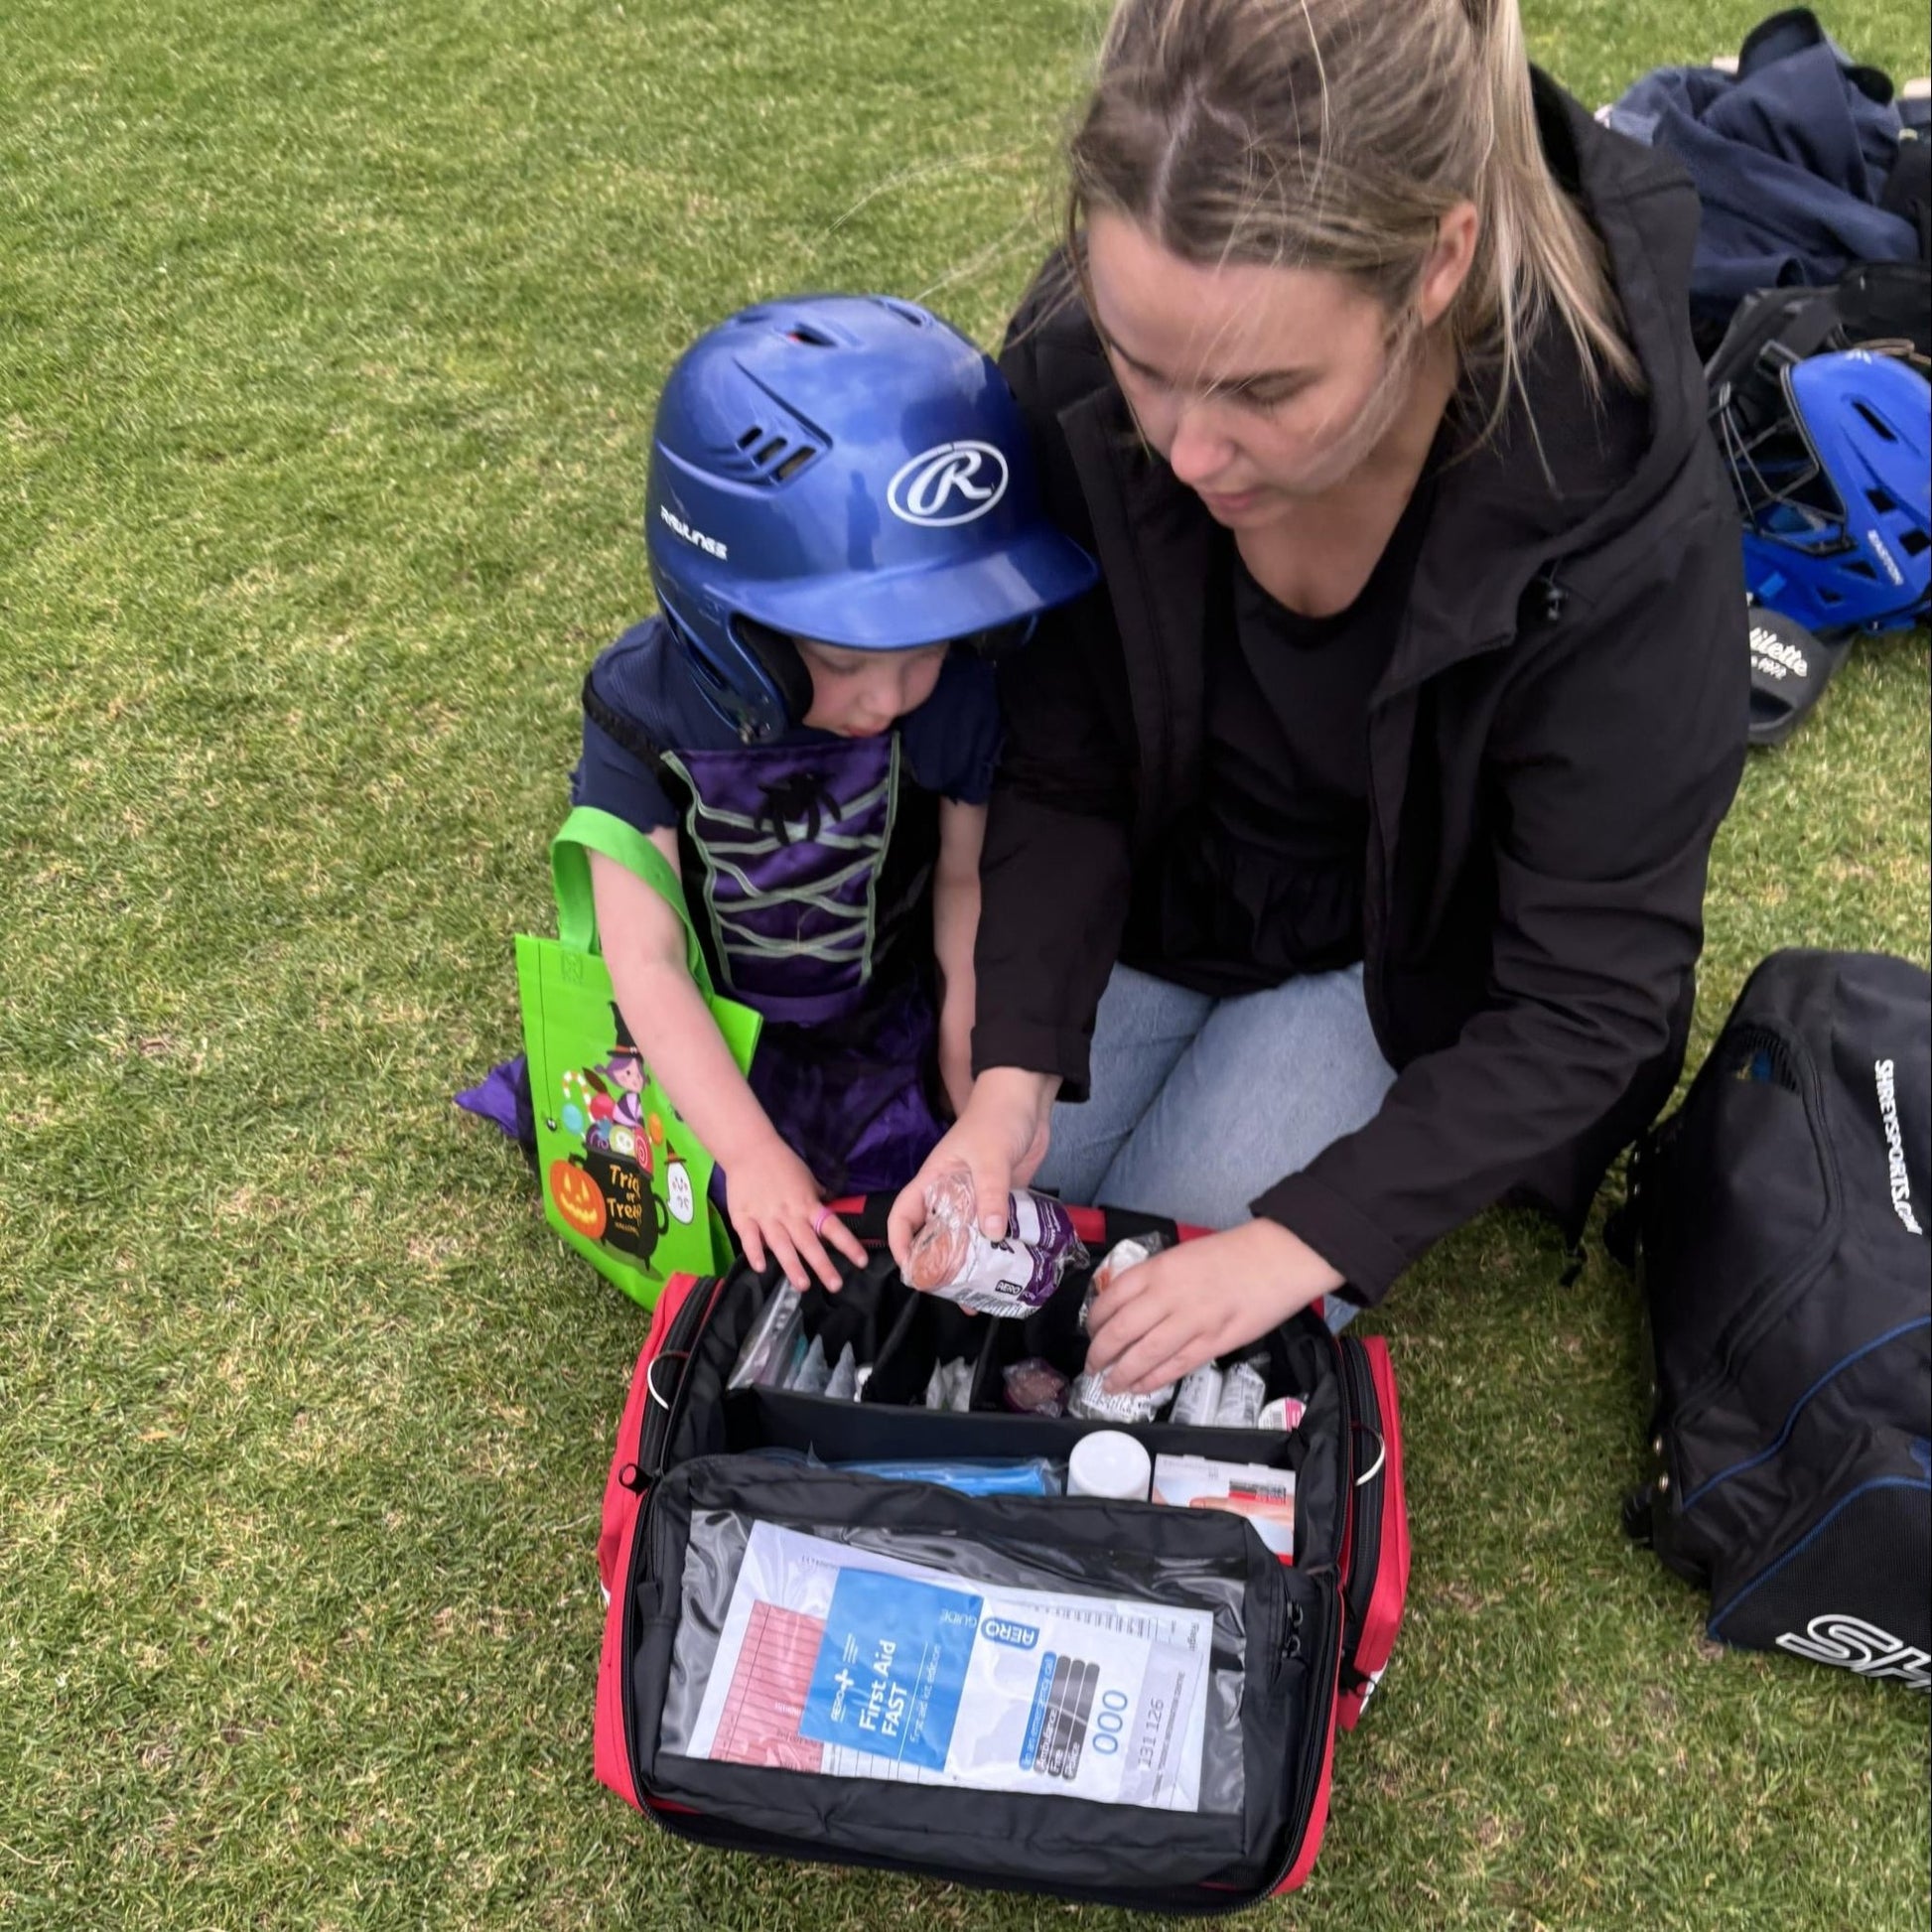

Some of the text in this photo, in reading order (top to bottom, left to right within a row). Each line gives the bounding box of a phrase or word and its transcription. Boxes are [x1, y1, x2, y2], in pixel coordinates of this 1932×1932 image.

[985, 1618, 1035, 1646] AERO
[859, 1638, 897, 1732] First Aid
[881, 1682, 907, 1737] FAST
[1092, 1690, 1128, 1754] 000
[1139, 1699, 1164, 1767] 131 126
